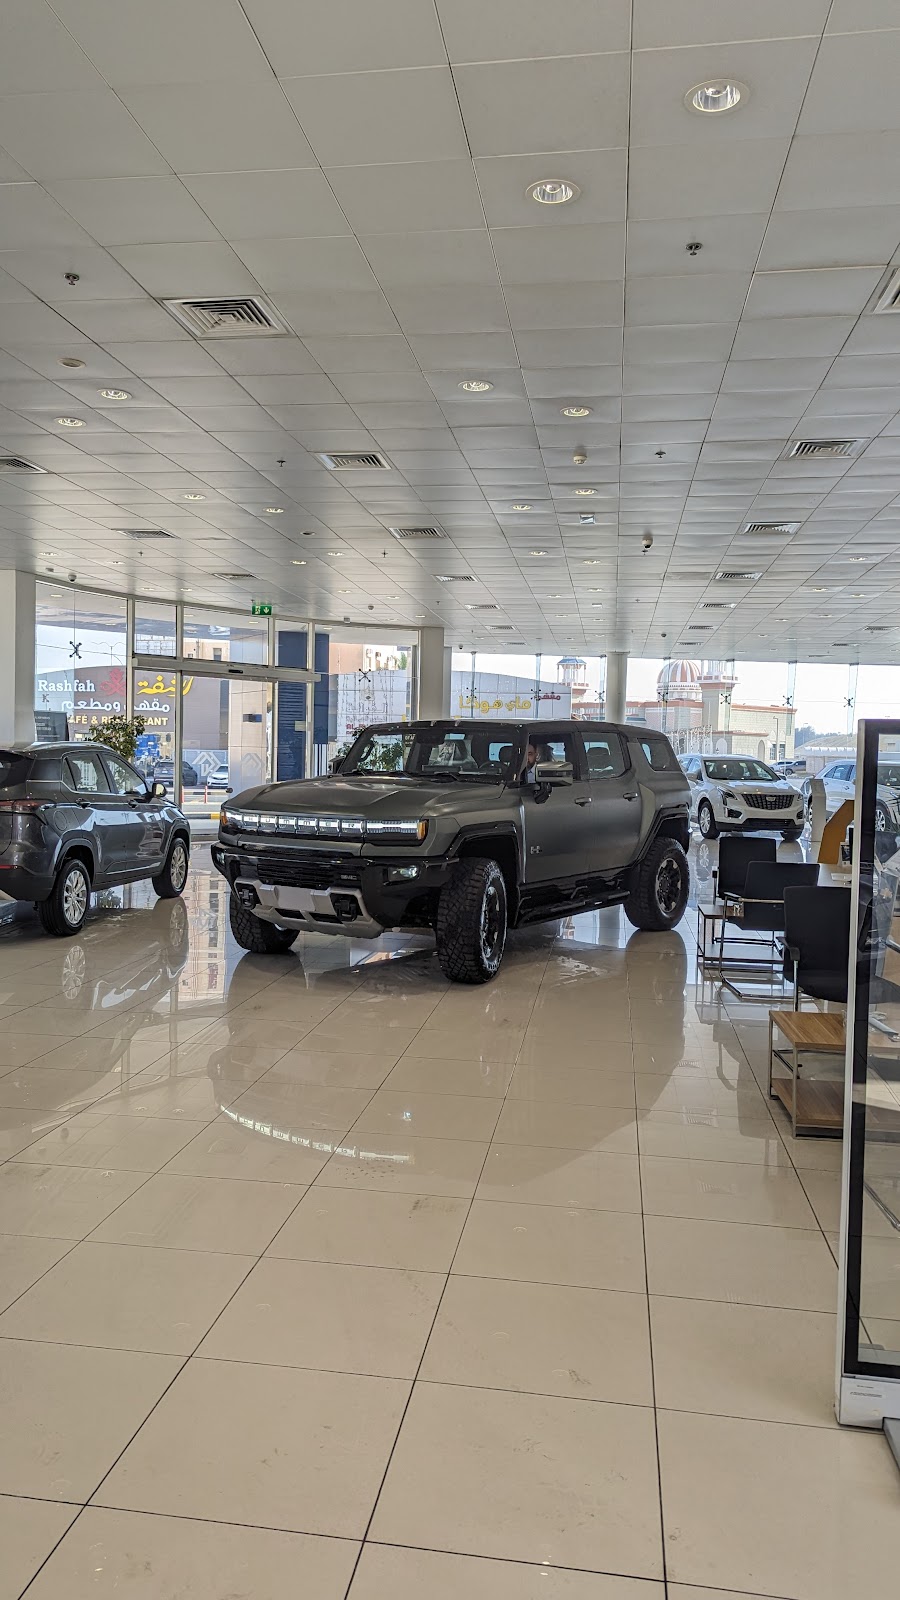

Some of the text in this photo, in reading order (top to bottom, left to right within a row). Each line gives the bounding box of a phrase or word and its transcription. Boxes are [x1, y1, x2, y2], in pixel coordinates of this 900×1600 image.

[37, 679, 95, 692] Rashfah
[61, 697, 121, 713] ومطعم
[67, 714, 88, 725] AFÉ
[91, 715, 99, 725] &
